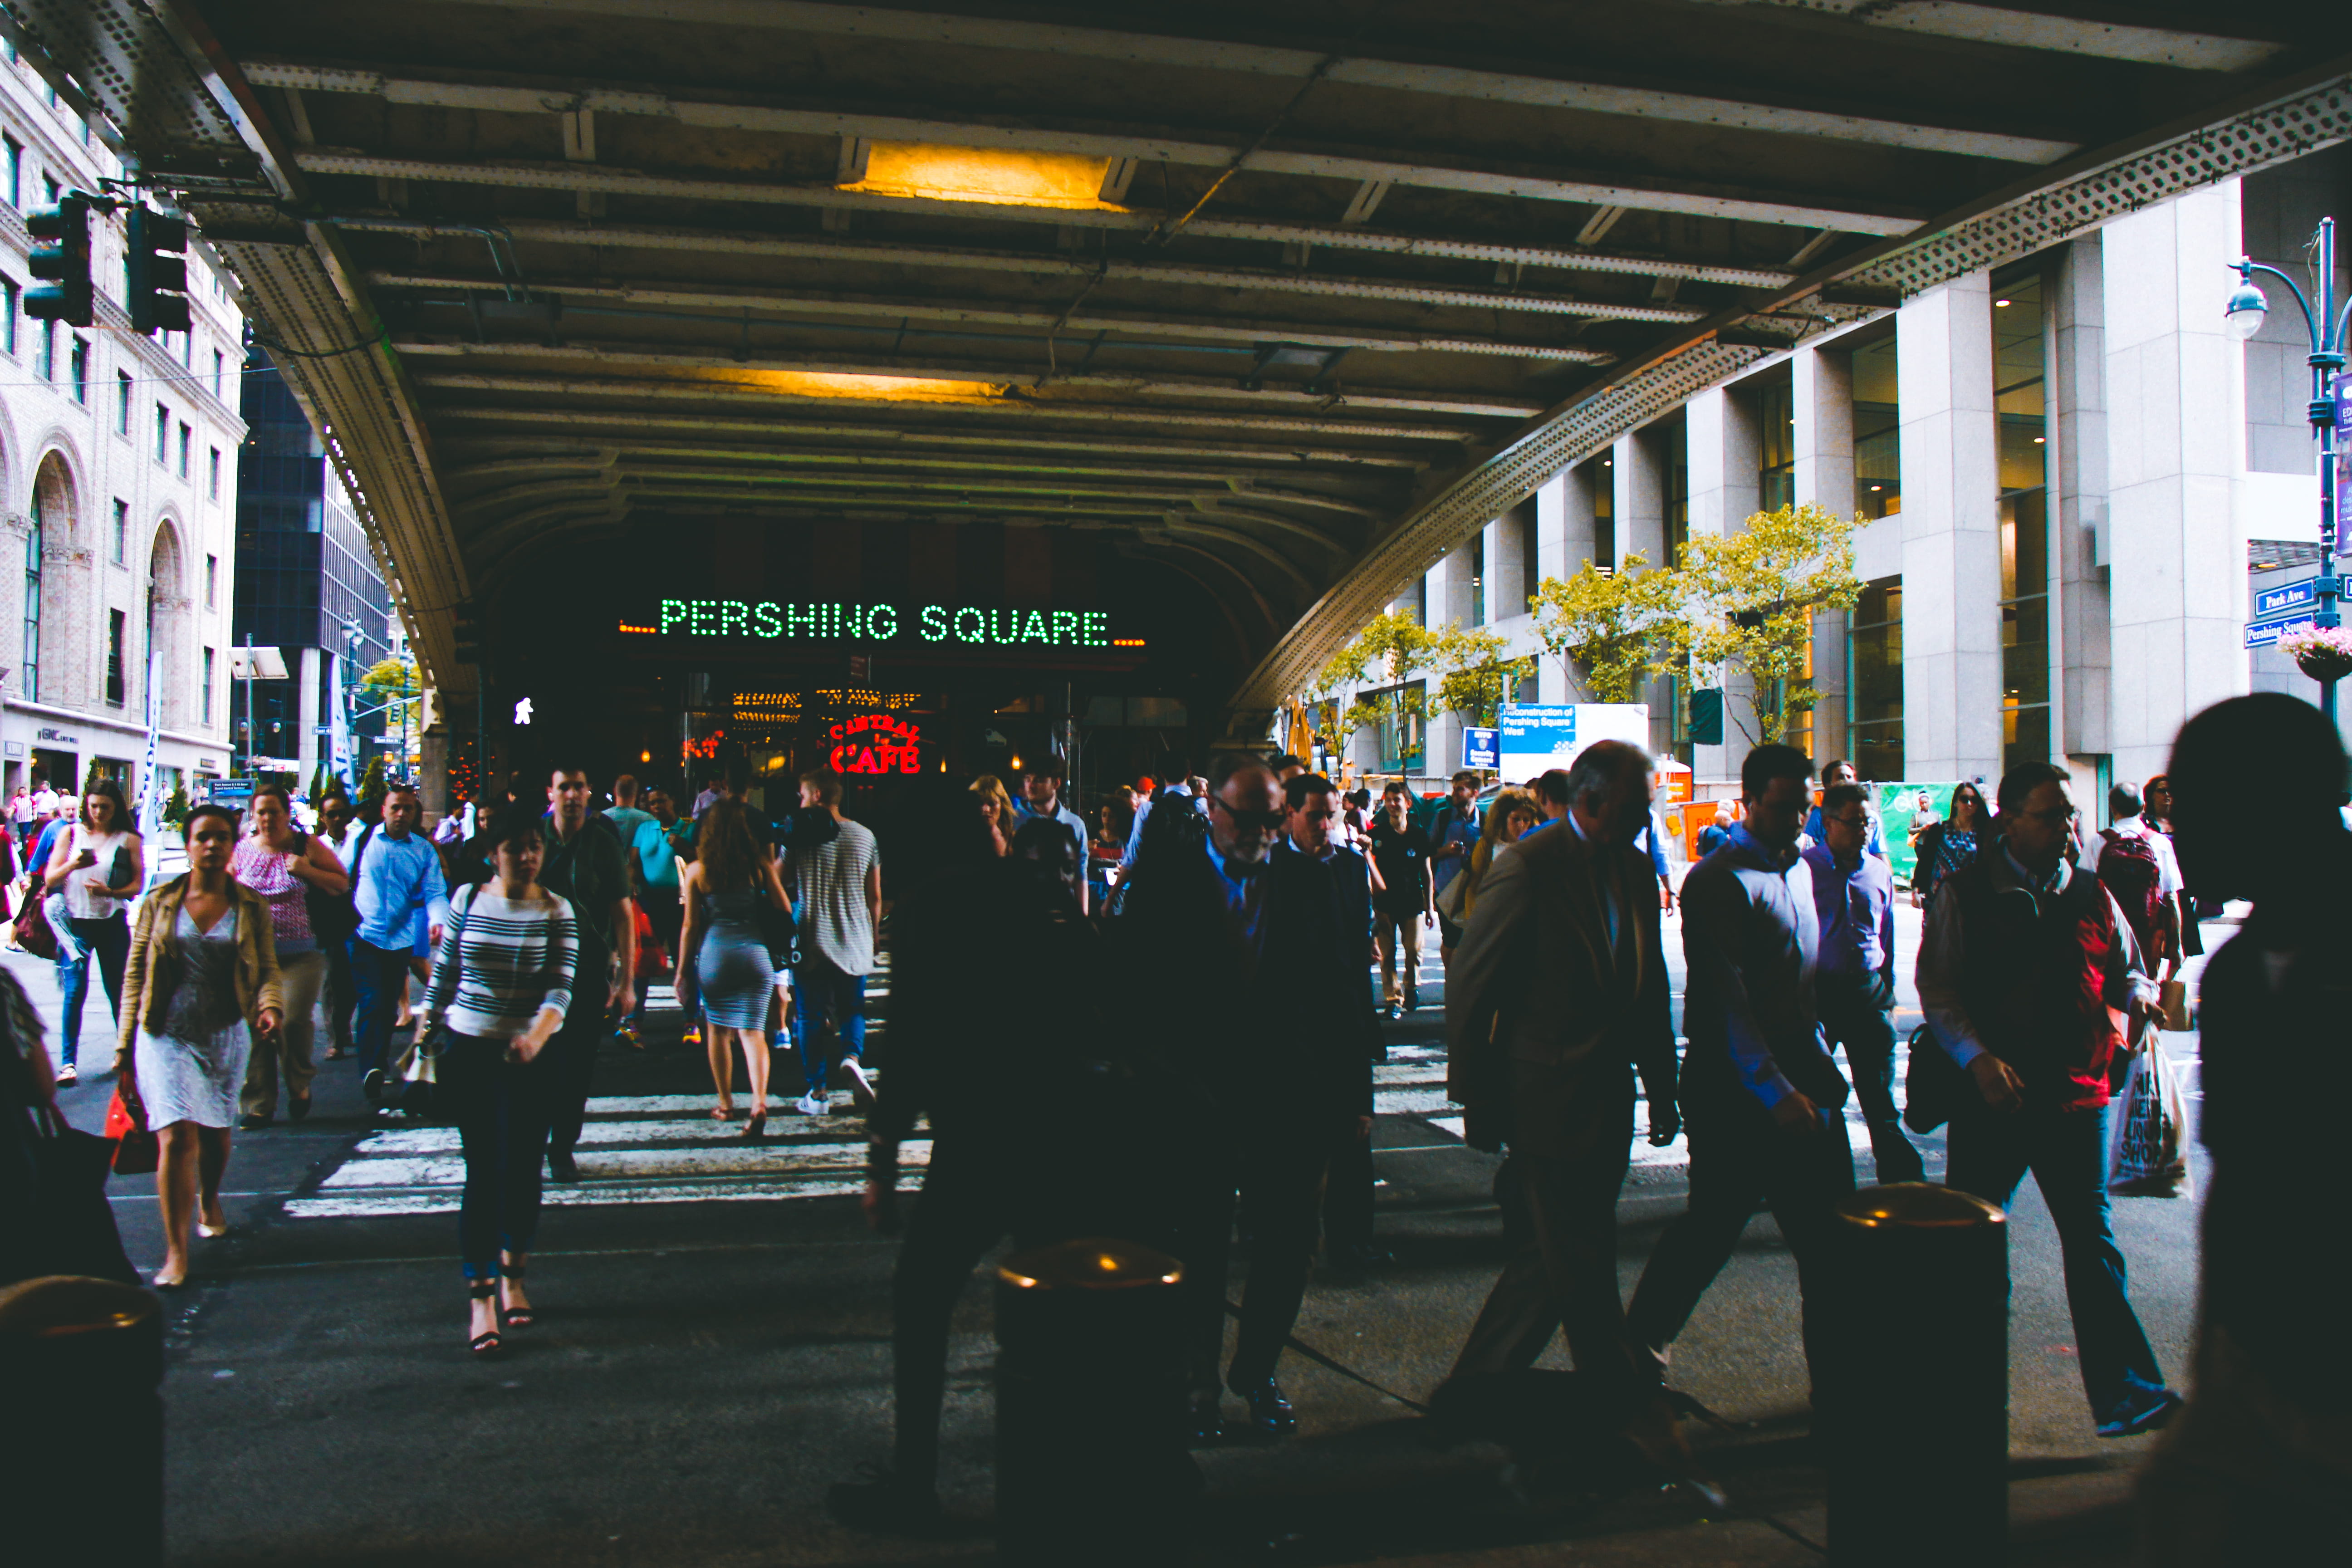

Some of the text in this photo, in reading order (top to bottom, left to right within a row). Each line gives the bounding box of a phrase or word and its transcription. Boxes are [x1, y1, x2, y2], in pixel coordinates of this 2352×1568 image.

[2265, 590, 2305, 609] Park Ave
[661, 599, 1107, 646] PERSHING SQUARE
[2247, 624, 2283, 642] Pershing
[1563, 707, 1573, 716] of
[1503, 717, 1570, 728] Pershing Square
[1474, 731, 1493, 739] NYPD
[1503, 727, 1525, 736] West
[8, 743, 23, 755] SUBWAY
[1470, 749, 1494, 759] Security
